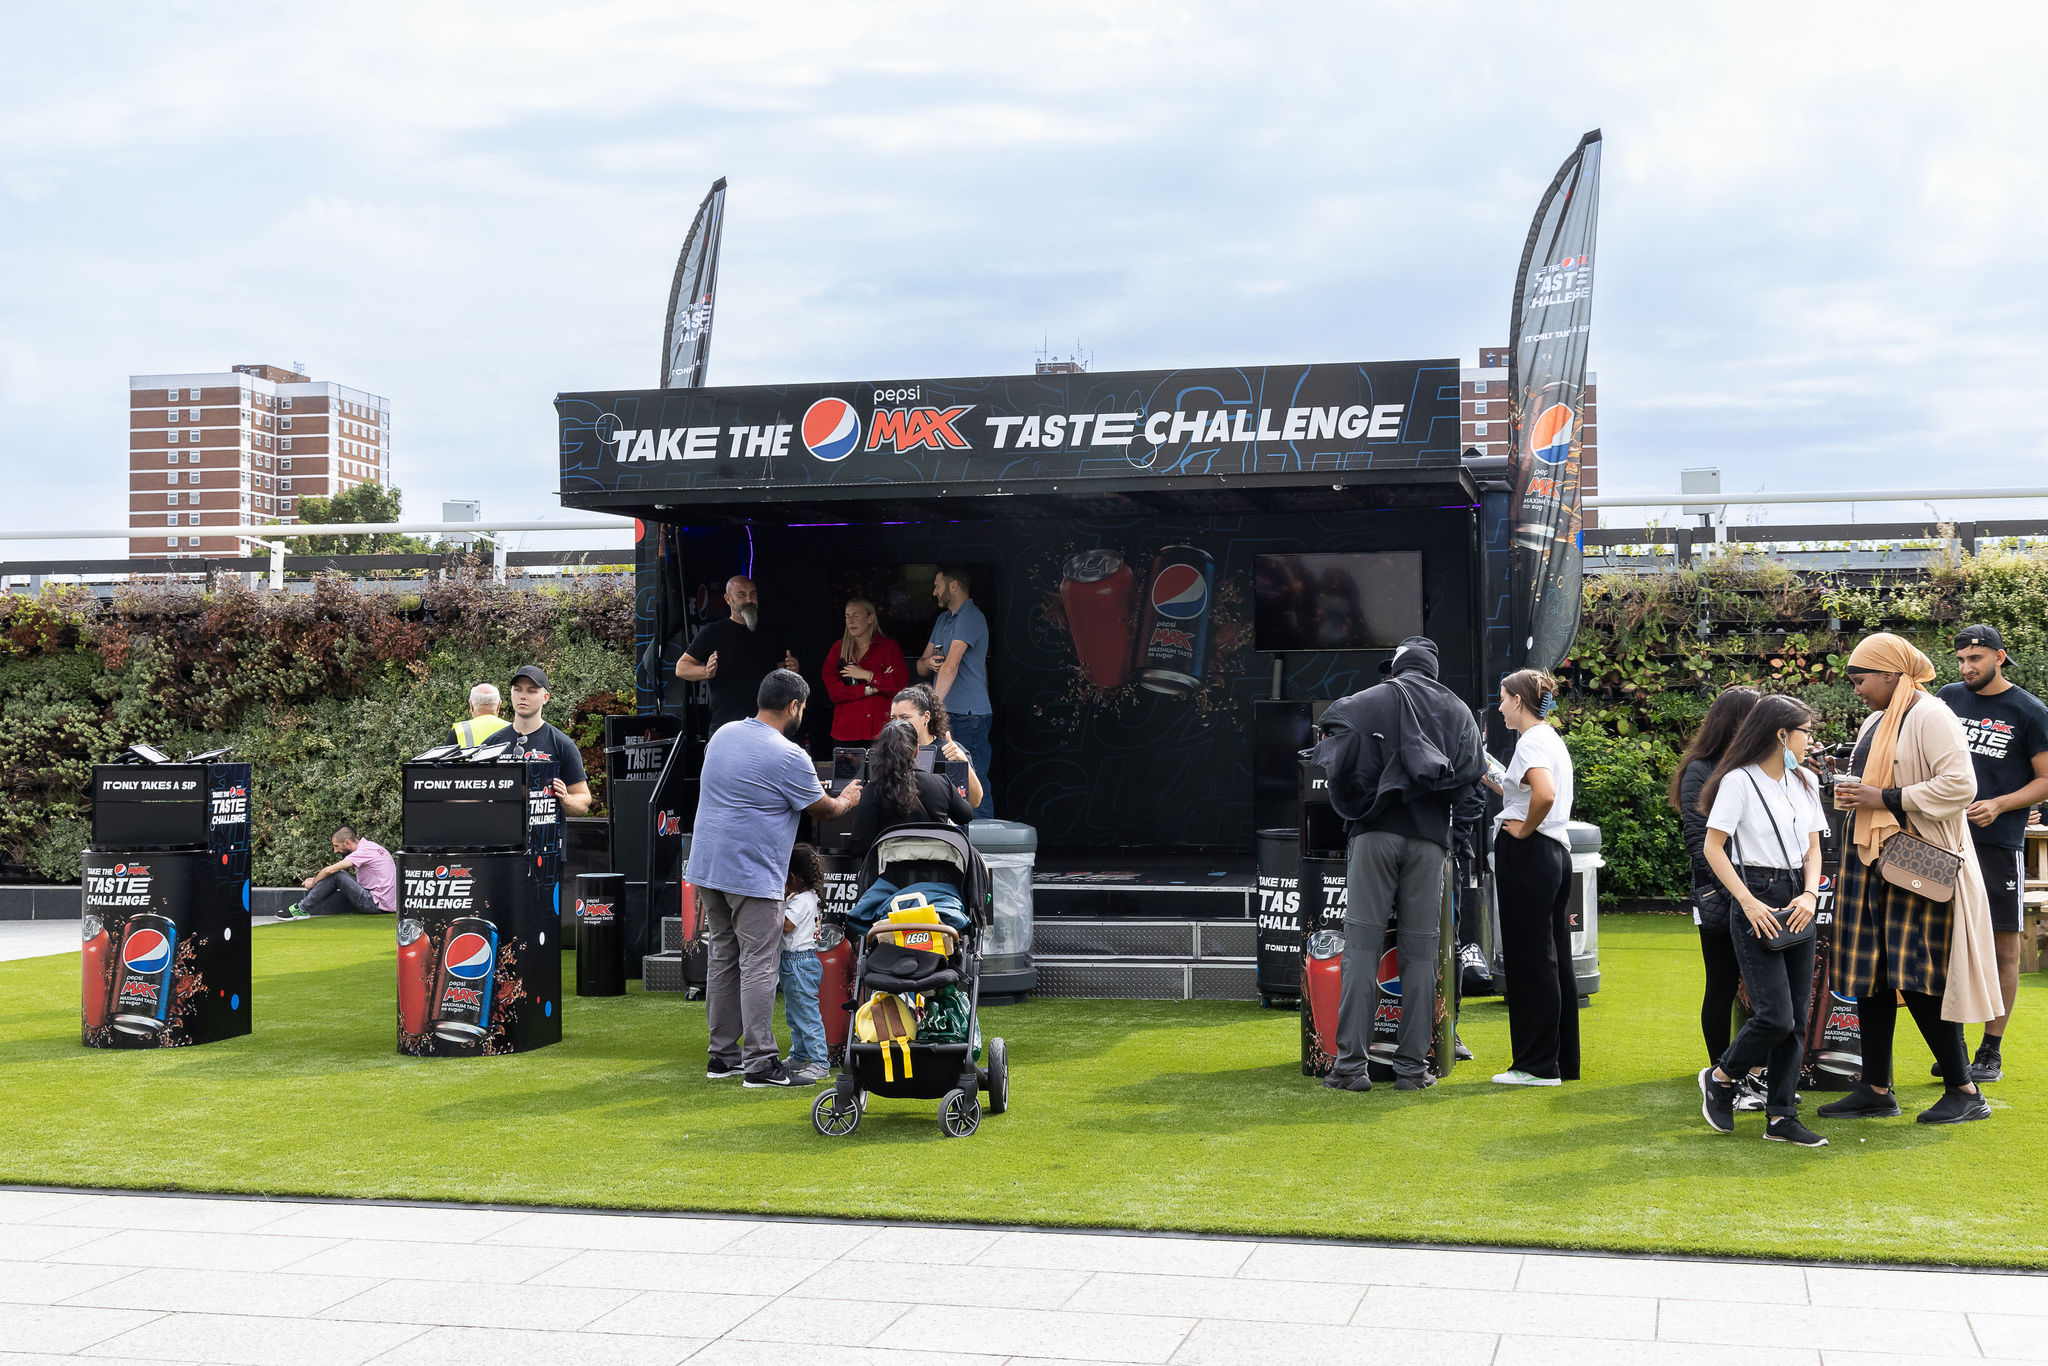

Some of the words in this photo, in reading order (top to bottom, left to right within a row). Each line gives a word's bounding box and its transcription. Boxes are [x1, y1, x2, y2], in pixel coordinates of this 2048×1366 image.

[873, 385, 921, 406] pepsi
[611, 426, 720, 463] TAKE
[728, 424, 794, 458] THE
[864, 404, 977, 455] MAX
[985, 411, 1139, 449] TASTE
[1144, 403, 1405, 445] CHALLENGE
[1149, 628, 1197, 652] MAX
[625, 747, 663, 770] TASTE
[102, 781, 113, 790] IT
[112, 781, 139, 790] ONLY
[140, 781, 172, 790] TAKES
[173, 781, 180, 790] A
[181, 781, 197, 790] SIP
[414, 780, 424, 789] IT
[424, 780, 453, 789] ONLY
[454, 780, 487, 789] TAKES
[488, 780, 496, 789] A
[498, 780, 515, 789] SIP
[211, 798, 247, 814] TASTE
[529, 798, 556, 814] TASTE
[212, 813, 247, 825] CHALLENGE
[529, 814, 557, 825] CHALLENGE
[1823, 828, 1832, 838] B
[87, 868, 101, 876] TAKE
[102, 868, 114, 876] THE
[127, 866, 151, 876] MAX
[404, 870, 421, 878] TAKE
[422, 870, 434, 878] THE
[448, 867, 473, 878] MAX
[823, 873, 842, 881] TAKE
[843, 873, 857, 881] THE
[1259, 875, 1279, 888] TAKE
[1280, 878, 1299, 889] THE
[1323, 876, 1346, 885] TAKE
[87, 877, 152, 893] TASTE
[404, 879, 473, 896] TASTE
[87, 895, 151, 906] CHALLENGE
[404, 898, 474, 909] CHALLENGE
[584, 903, 615, 917] MAX
[906, 932, 930, 945] LEGO
[1270, 944, 1288, 952] ONLY
[120, 980, 160, 1000] MAX
[442, 986, 484, 1006] MAX
[1832, 1005, 1852, 1013] pepsi
[1824, 1029, 1852, 1037] MAXIMUM
[1832, 1035, 1850, 1043] sugar
